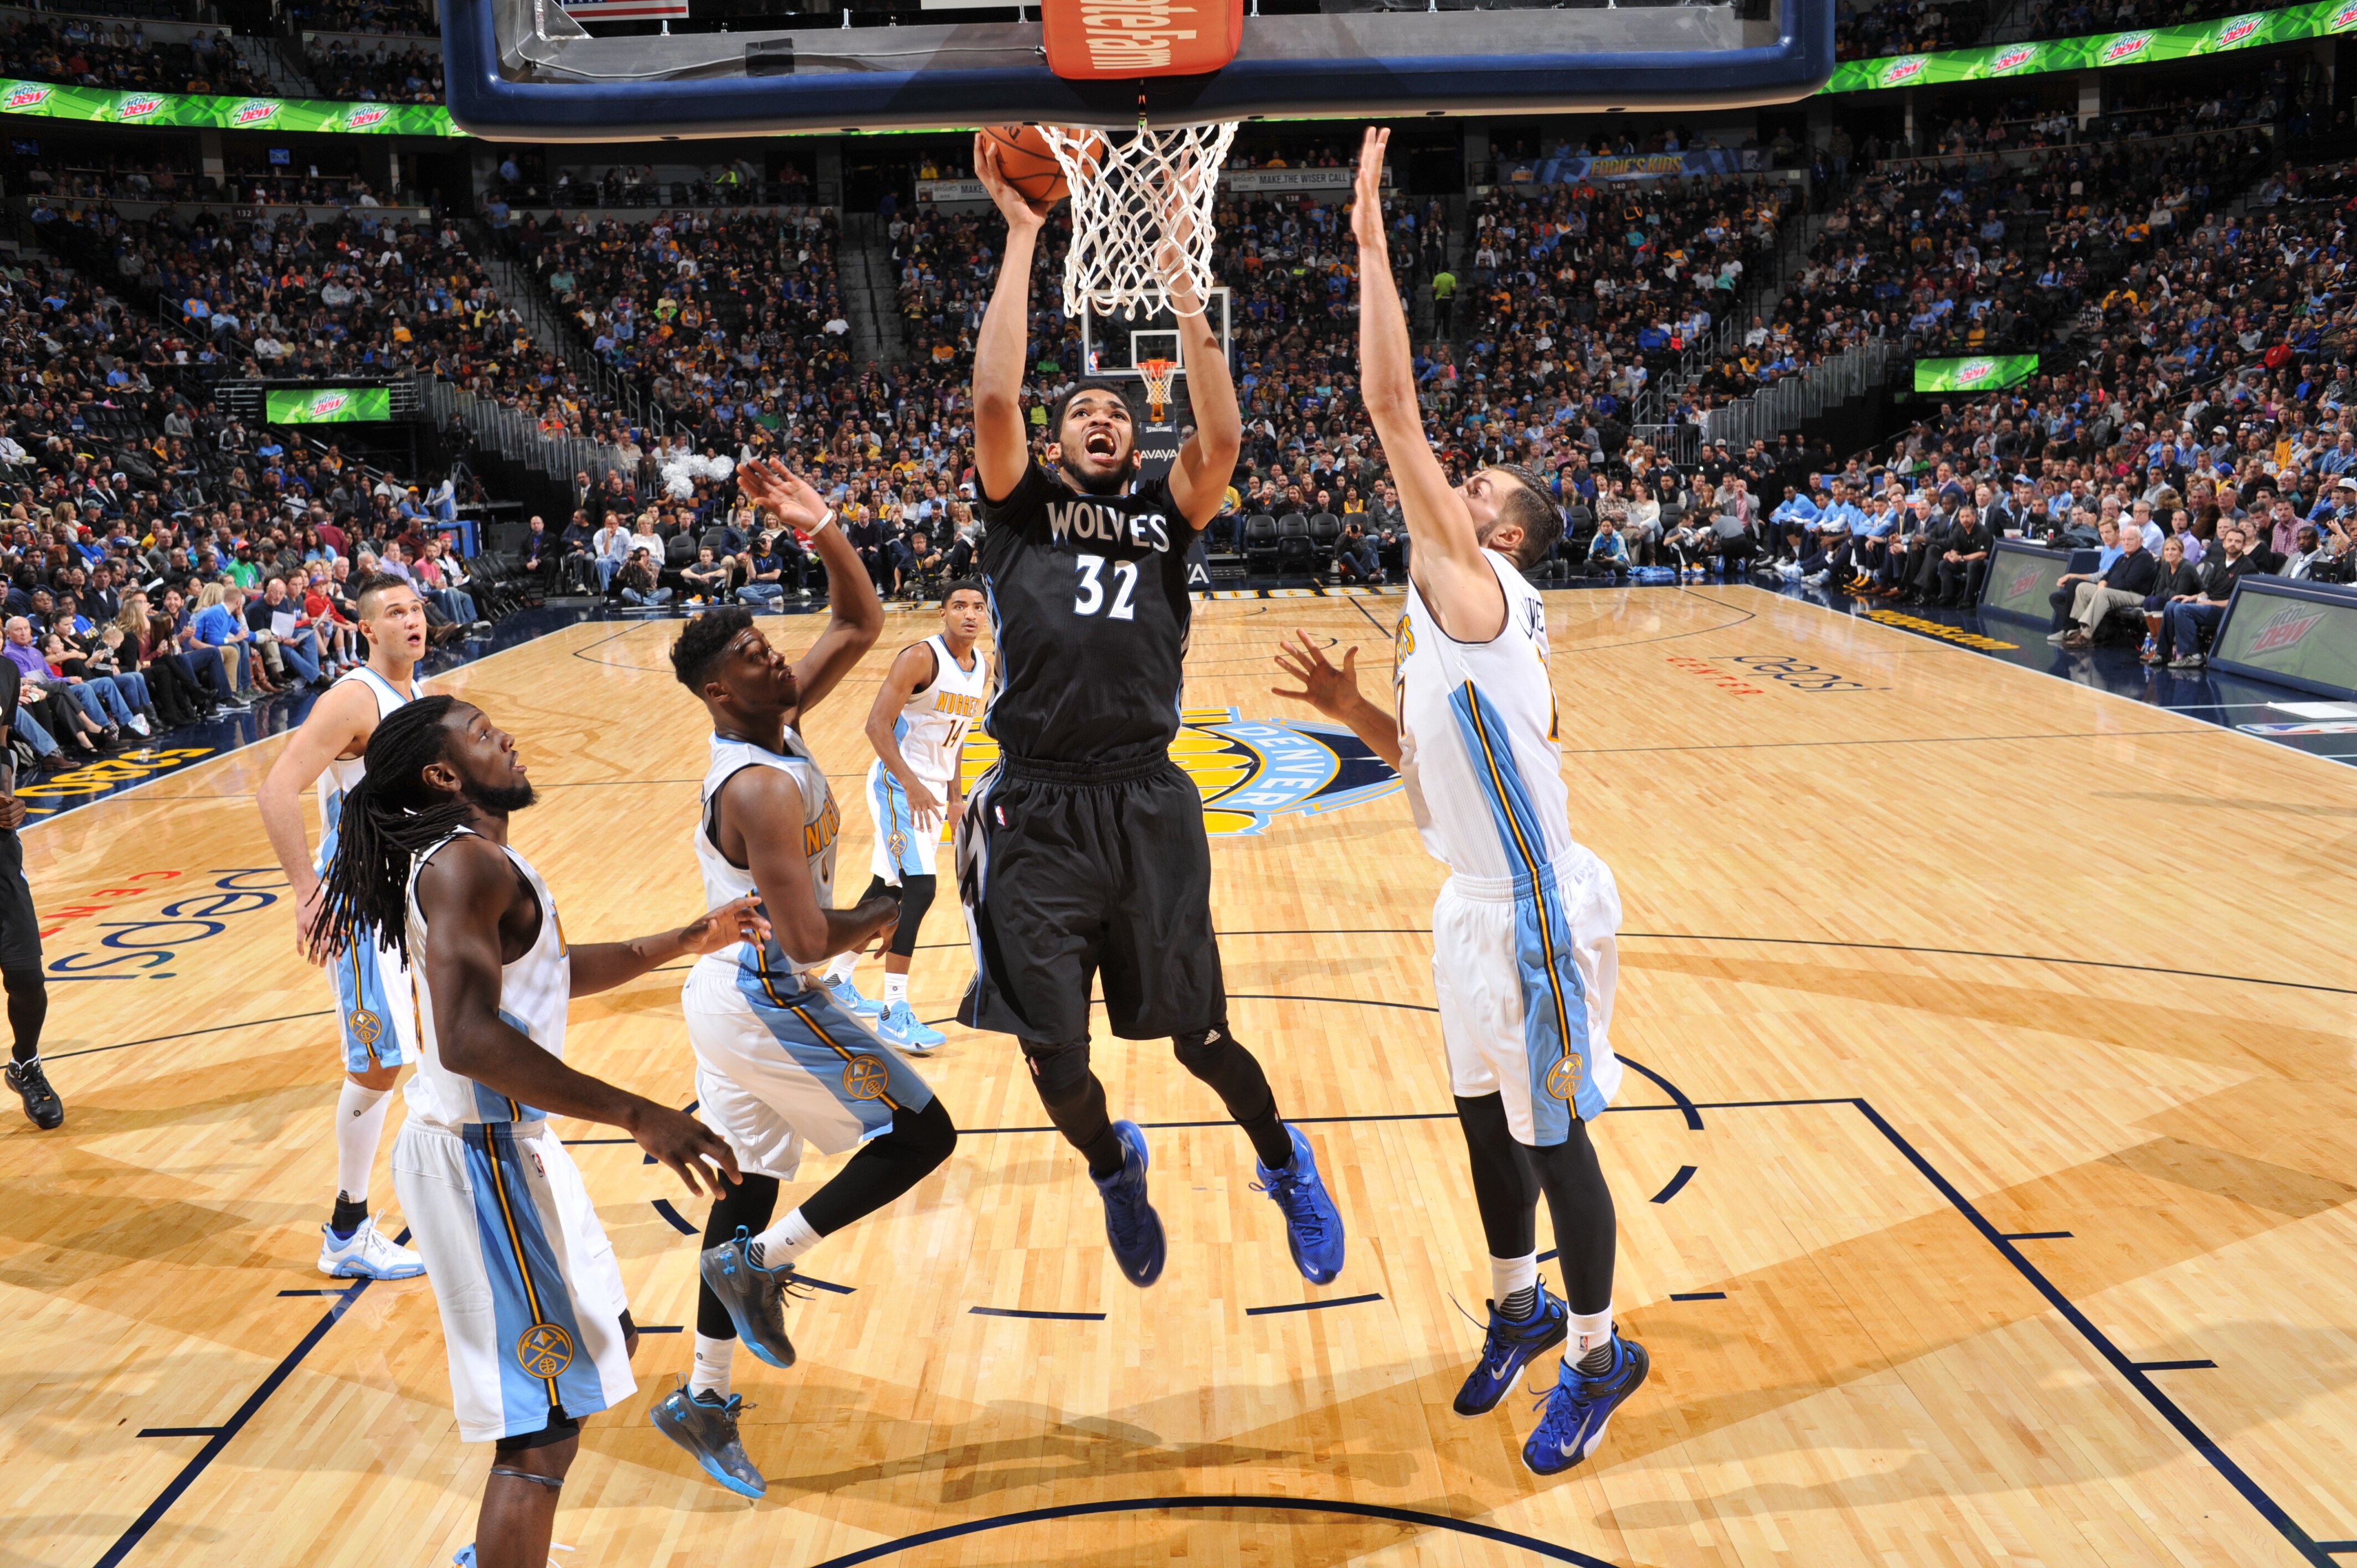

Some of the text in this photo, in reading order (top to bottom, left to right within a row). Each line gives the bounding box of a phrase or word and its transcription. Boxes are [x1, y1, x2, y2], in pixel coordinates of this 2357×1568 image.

[1259, 171, 1347, 184] MAKE THE WISER CALL
[1591, 156, 1682, 177] EDDIE'S KIDS
[961, 184, 983, 193] MAKE
[1141, 449, 1177, 462] AVAYA
[1046, 501, 1170, 553] WOLVES
[1073, 554, 1139, 622] 32
[1666, 657, 1764, 695] CENTER
[1708, 656, 1893, 692] pepsi
[941, 719, 964, 748] 14
[14, 748, 215, 797] 5280
[1224, 726, 1325, 806] DENVER
